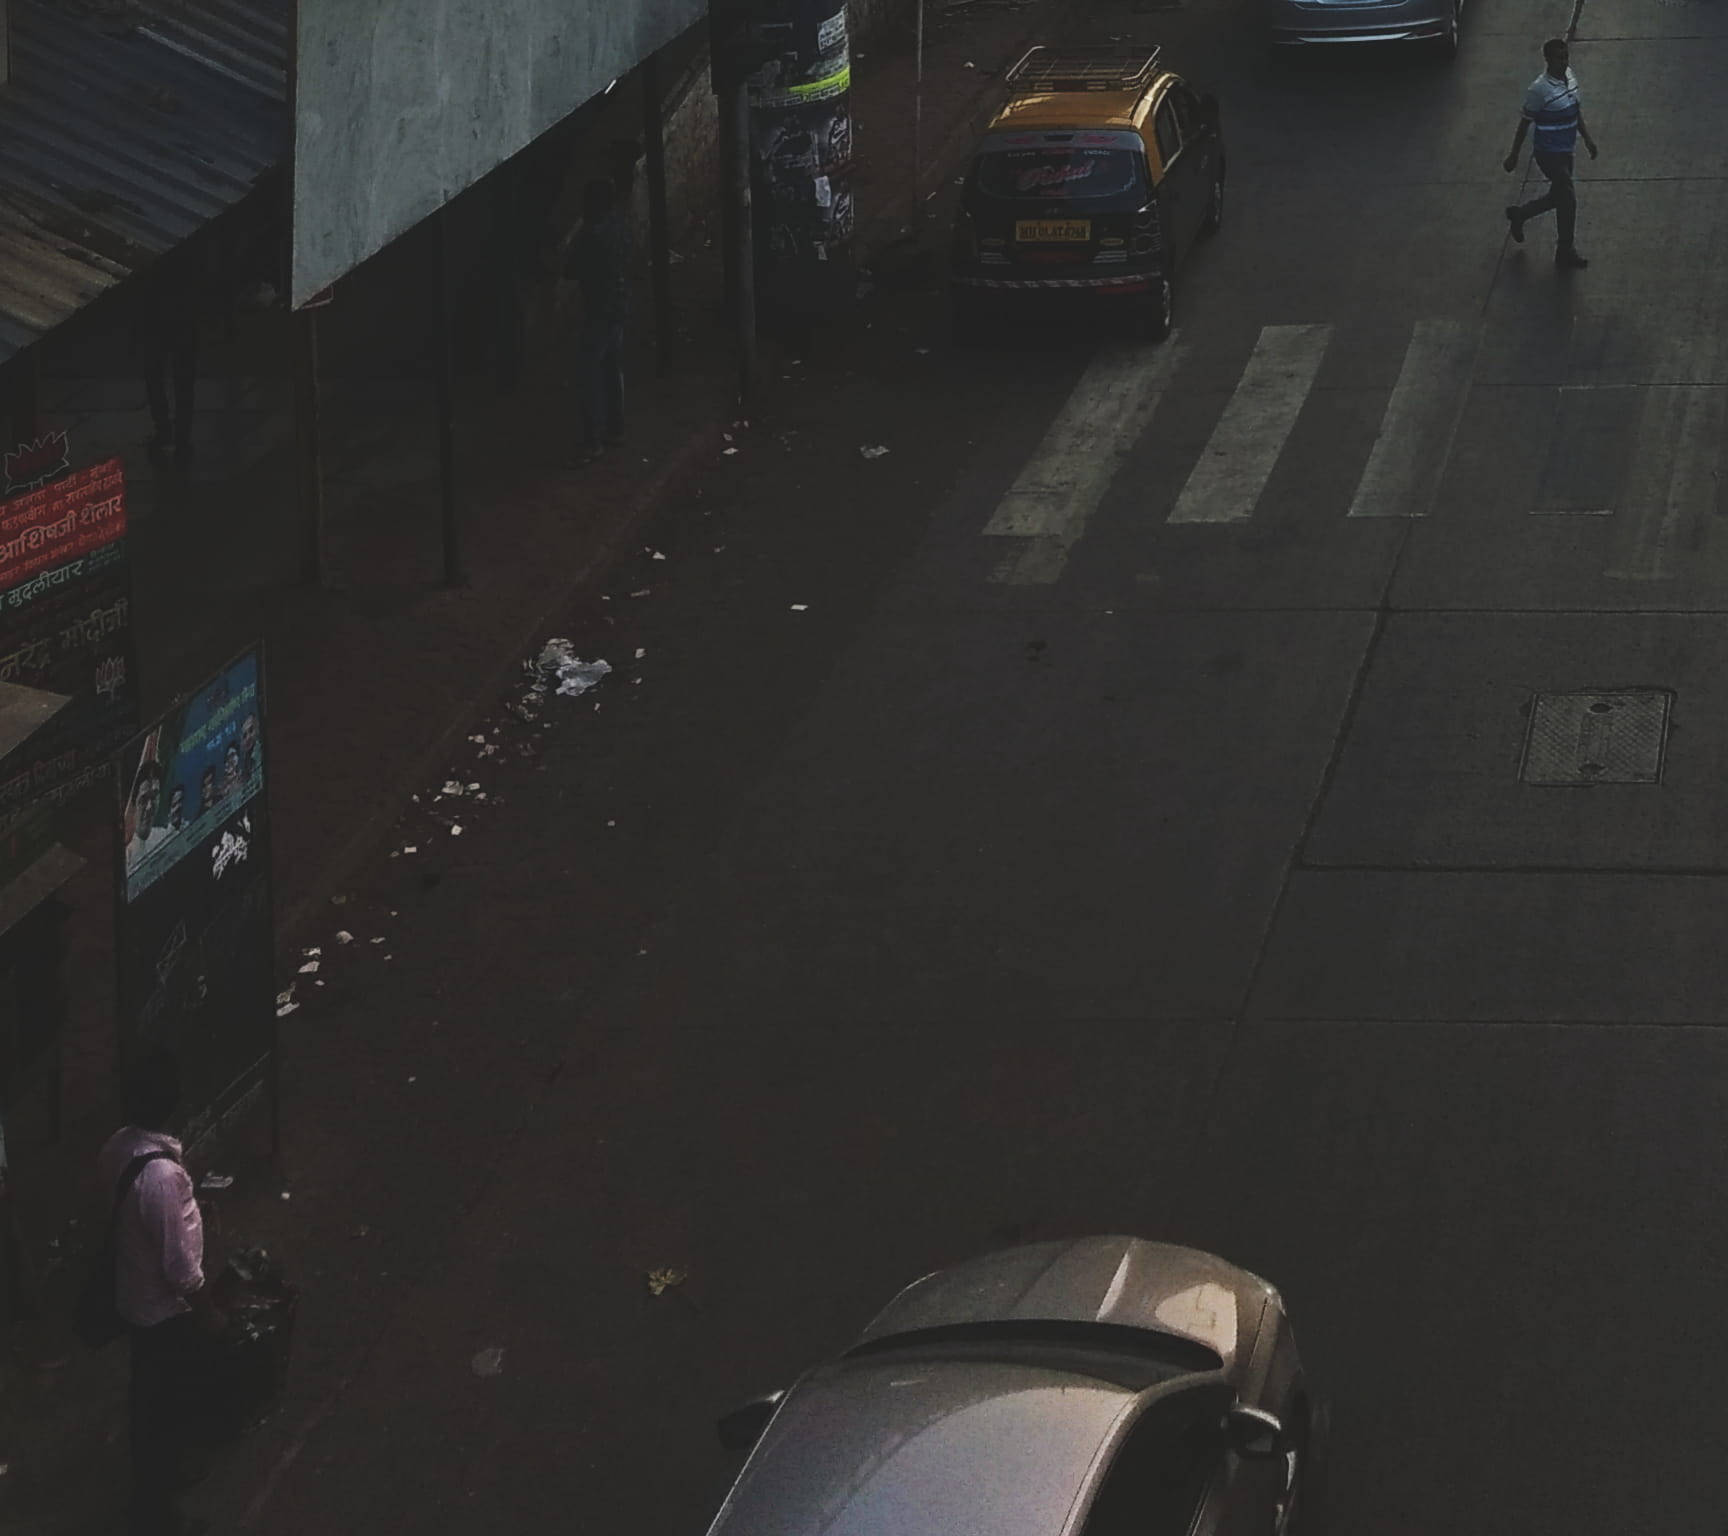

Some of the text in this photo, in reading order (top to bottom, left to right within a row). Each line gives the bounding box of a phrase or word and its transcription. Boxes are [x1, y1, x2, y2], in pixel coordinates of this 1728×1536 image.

[0, 509, 77, 564] आशिषजी
[80, 493, 124, 526] शेलार
[7, 559, 85, 608] मुदलीयार
